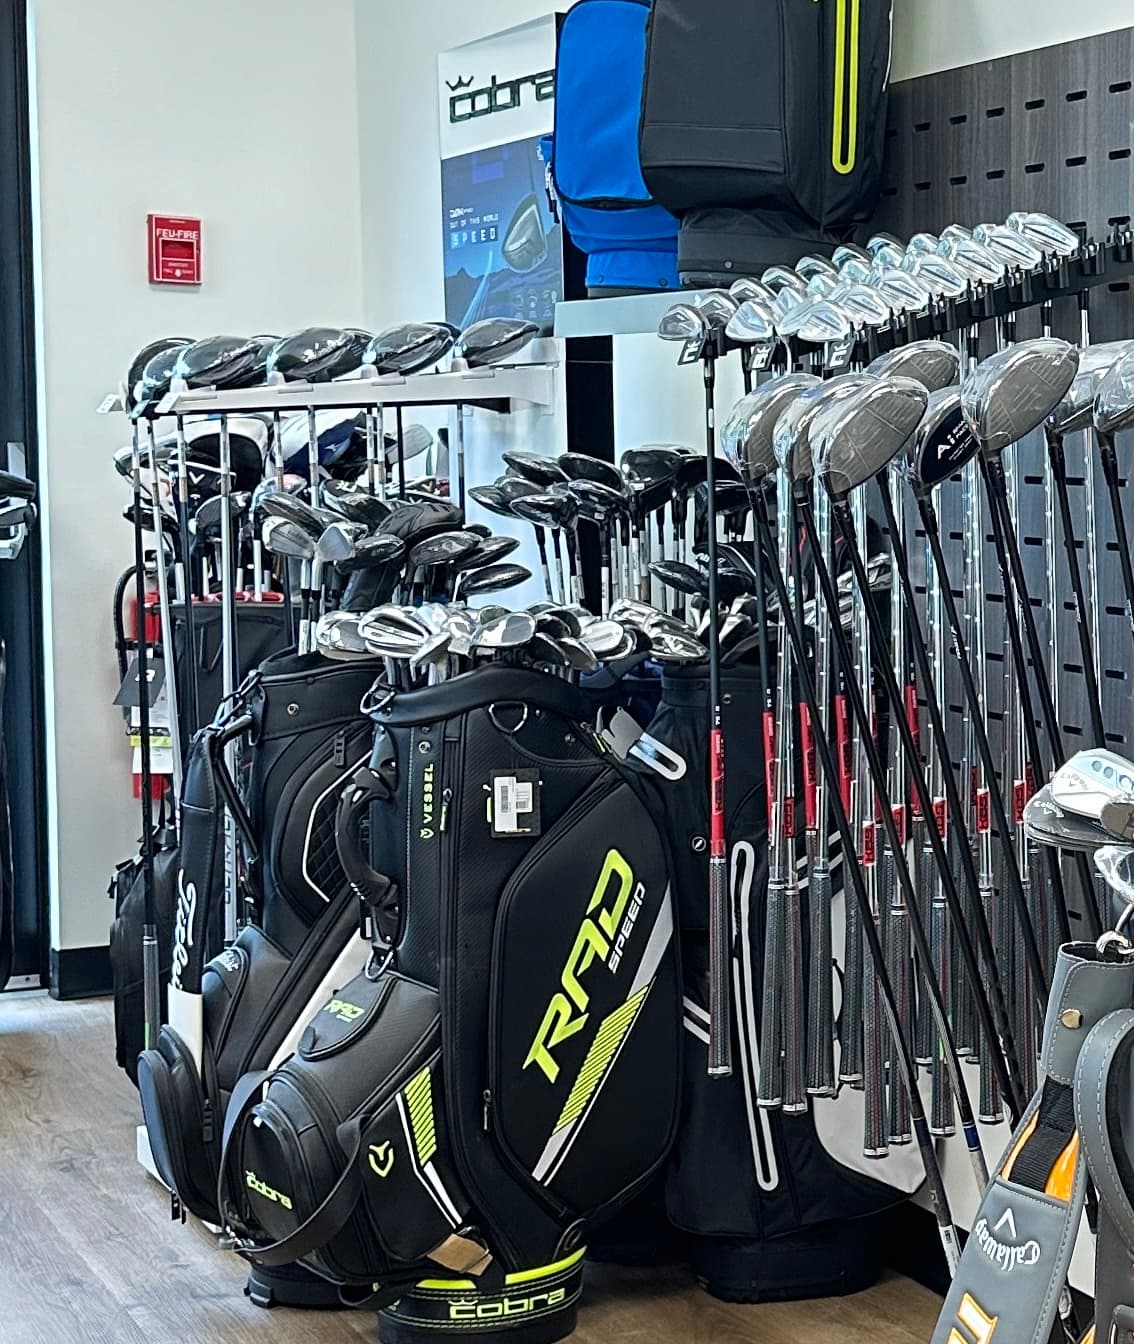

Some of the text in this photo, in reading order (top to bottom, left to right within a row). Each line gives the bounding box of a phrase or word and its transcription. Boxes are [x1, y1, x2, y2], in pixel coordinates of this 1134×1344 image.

[423, 763, 434, 824] VESSEL
[171, 868, 197, 991] Titlei
[607, 881, 646, 975] SPEED
[522, 849, 634, 1085] RAD
[323, 999, 365, 1019] RAD
[246, 1175, 293, 1210] cobra
[974, 1218, 1041, 1273] Callaway
[449, 1287, 566, 1319] cobra
